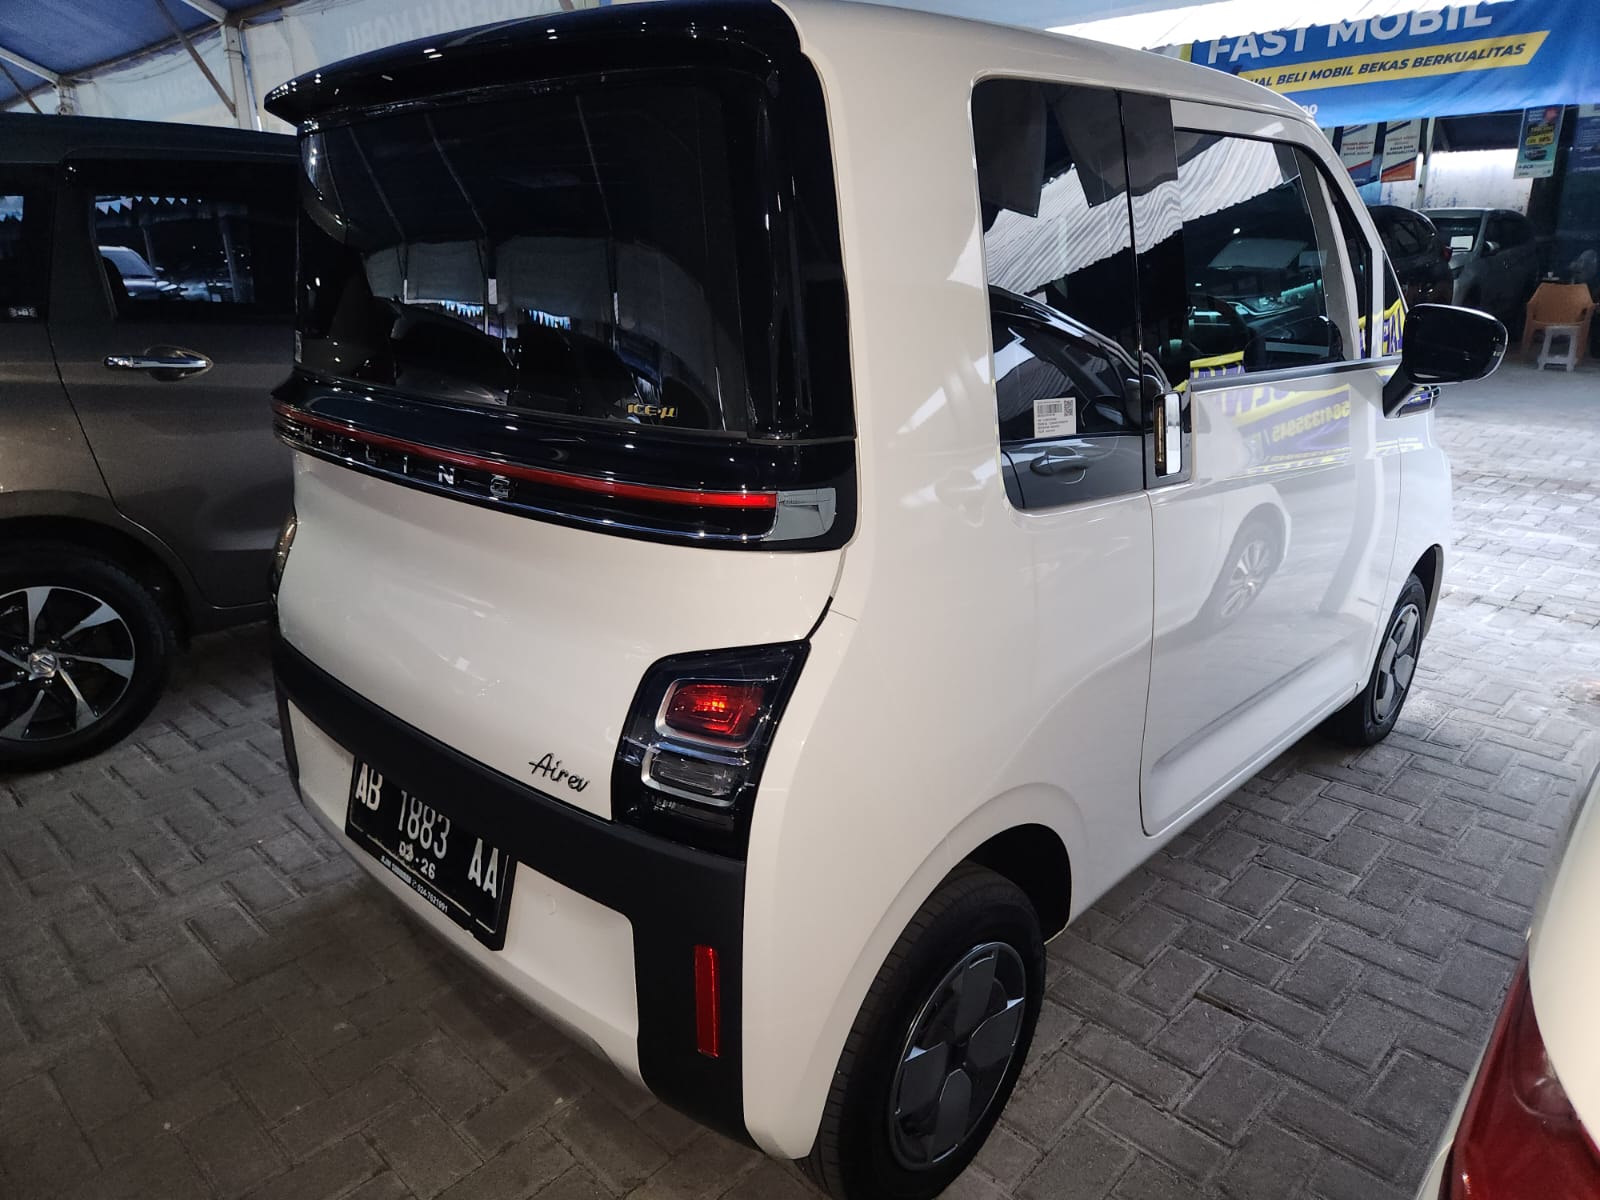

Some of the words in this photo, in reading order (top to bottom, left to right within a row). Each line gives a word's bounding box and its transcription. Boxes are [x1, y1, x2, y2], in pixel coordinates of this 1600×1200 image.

[1327, 5, 1493, 48] MOBIL
[1276, 71, 1307, 85] BELI
[1308, 64, 1353, 81] MOBIL
[1358, 57, 1409, 76] BEKAS
[1412, 43, 1525, 68] BERKUALITAS
[355, 762, 382, 811] AB
[398, 789, 450, 859] 1883
[468, 838, 499, 898] AA
